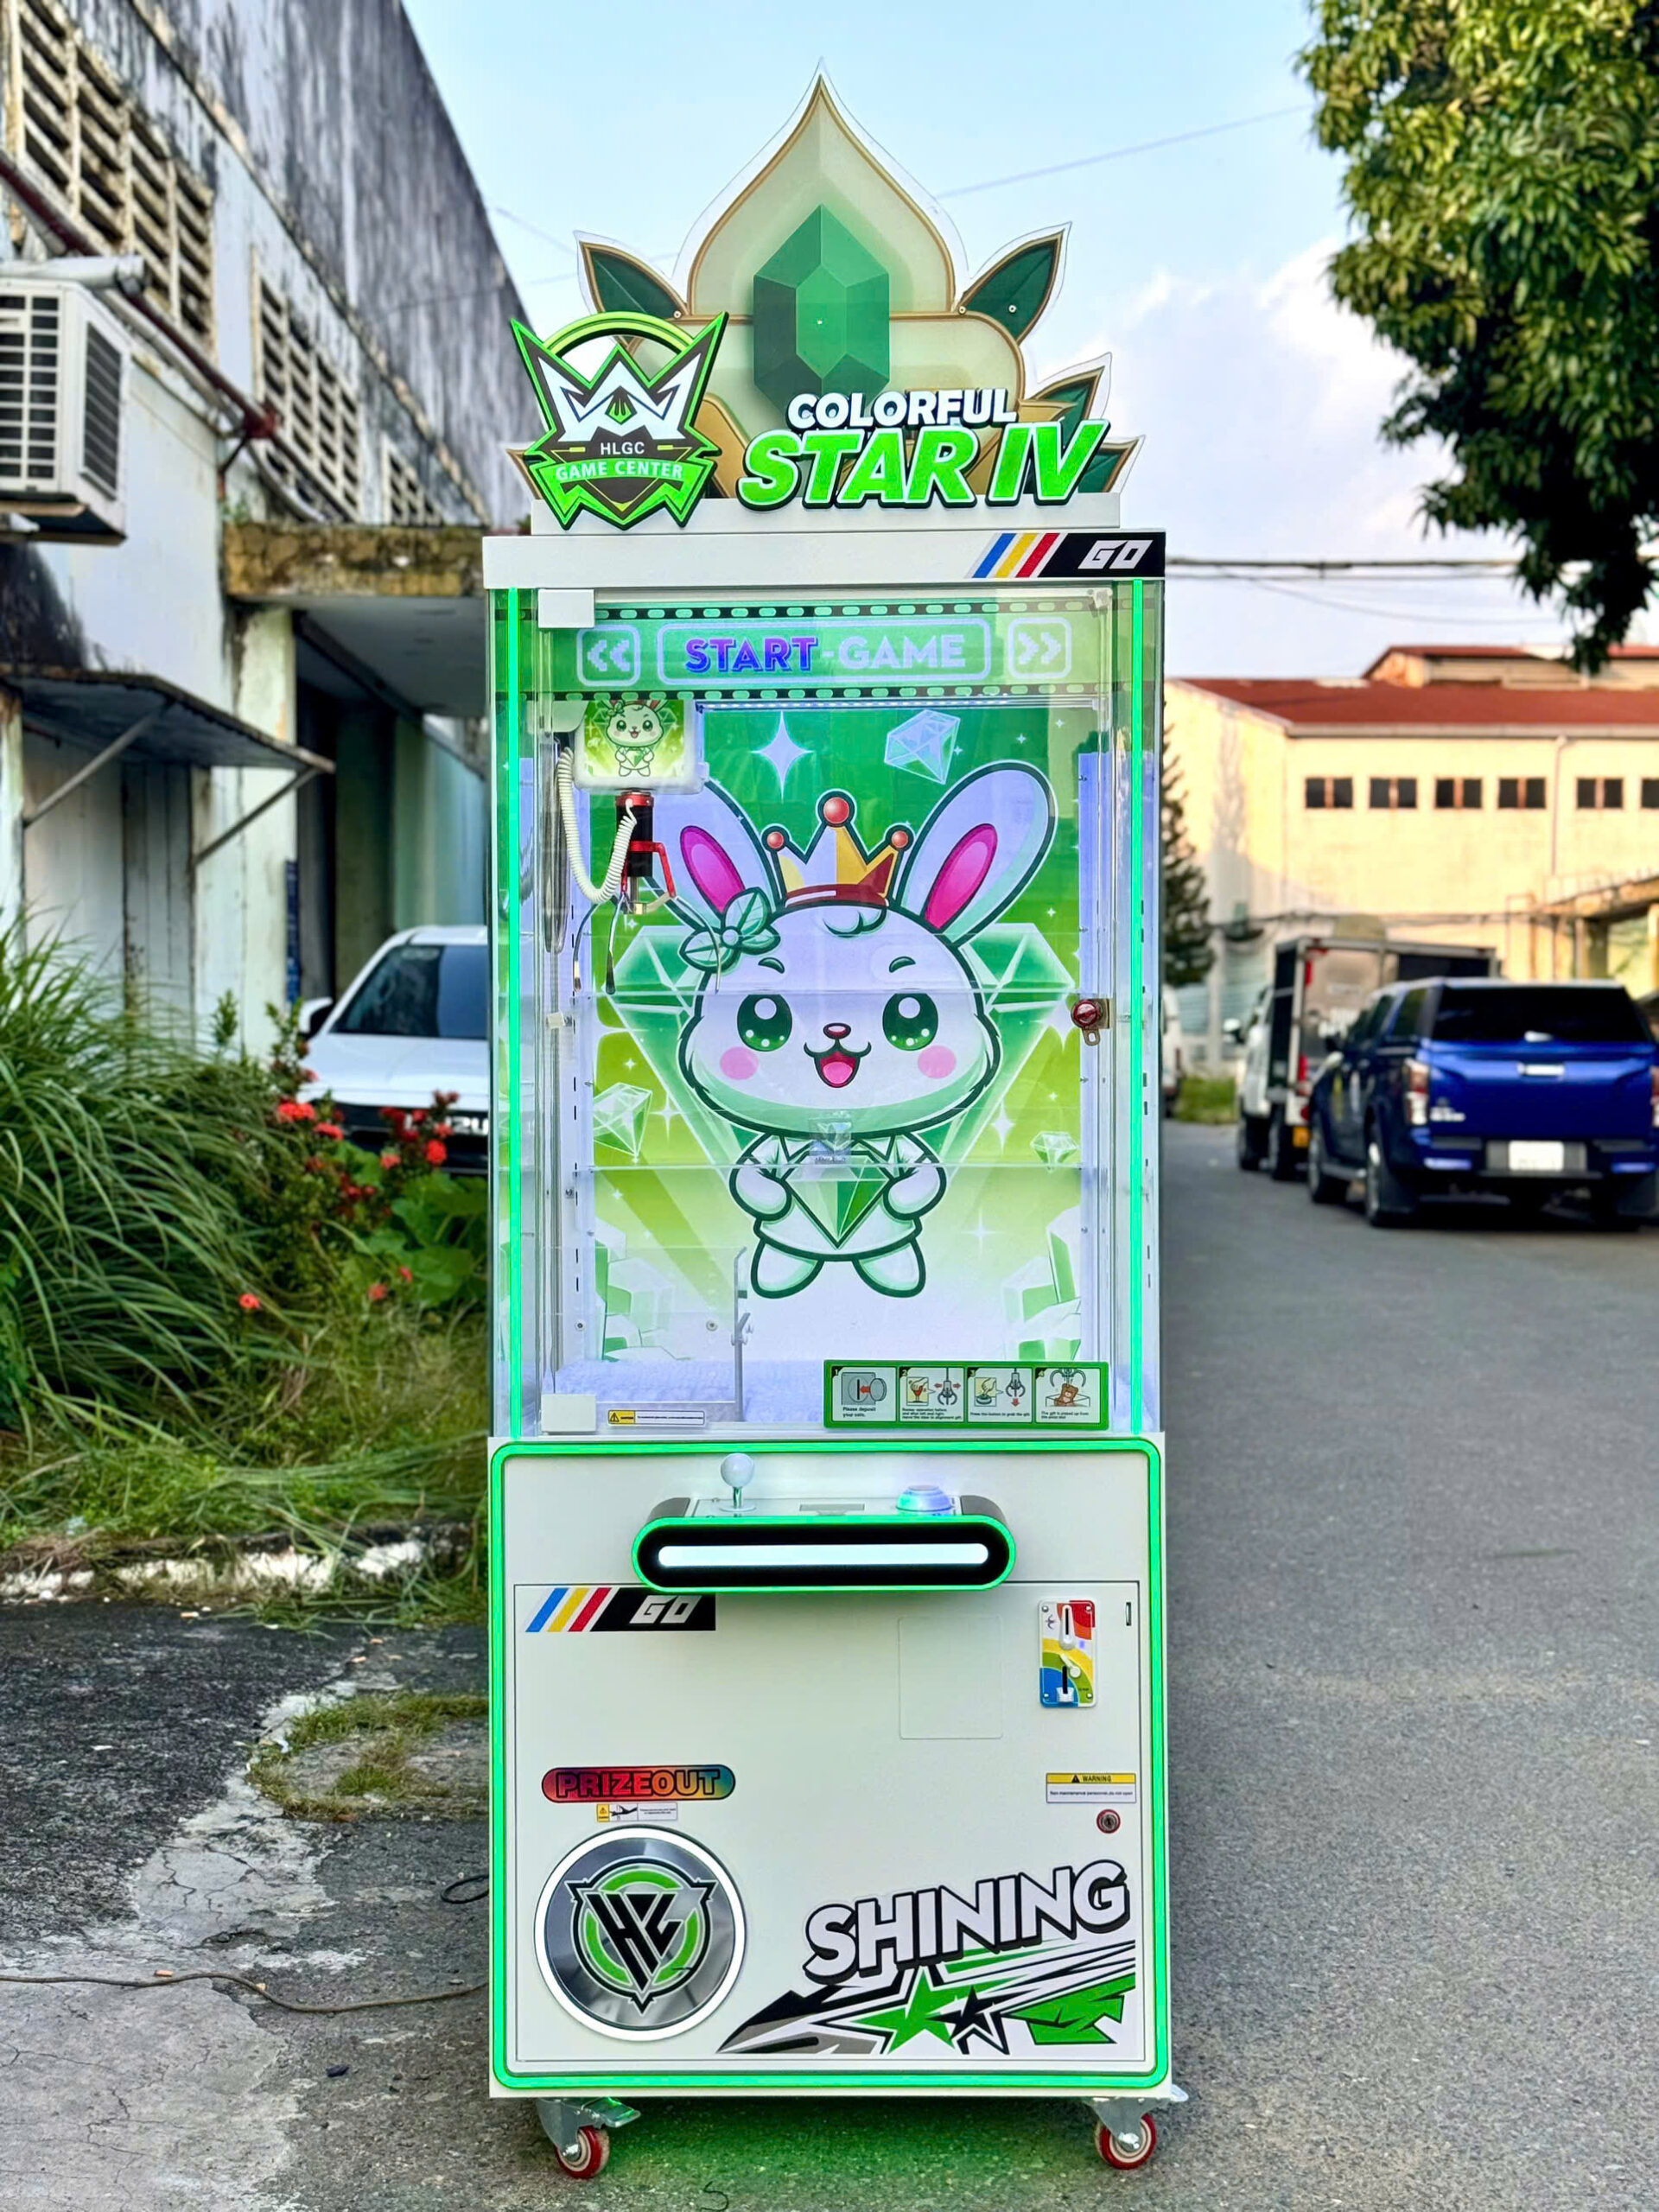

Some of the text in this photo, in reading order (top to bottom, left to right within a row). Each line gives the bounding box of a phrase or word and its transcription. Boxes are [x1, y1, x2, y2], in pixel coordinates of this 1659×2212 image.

[787, 388, 1018, 429] COLORFUL
[600, 442, 645, 455] HLGC
[556, 461, 683, 481] GAME CENTER
[737, 419, 1110, 509] STAR IV
[1077, 539, 1154, 570] GO
[629, 1594, 702, 1624] GO
[556, 1768, 721, 1798] PRIZEOUT
[802, 1859, 1130, 1985] SHINING
